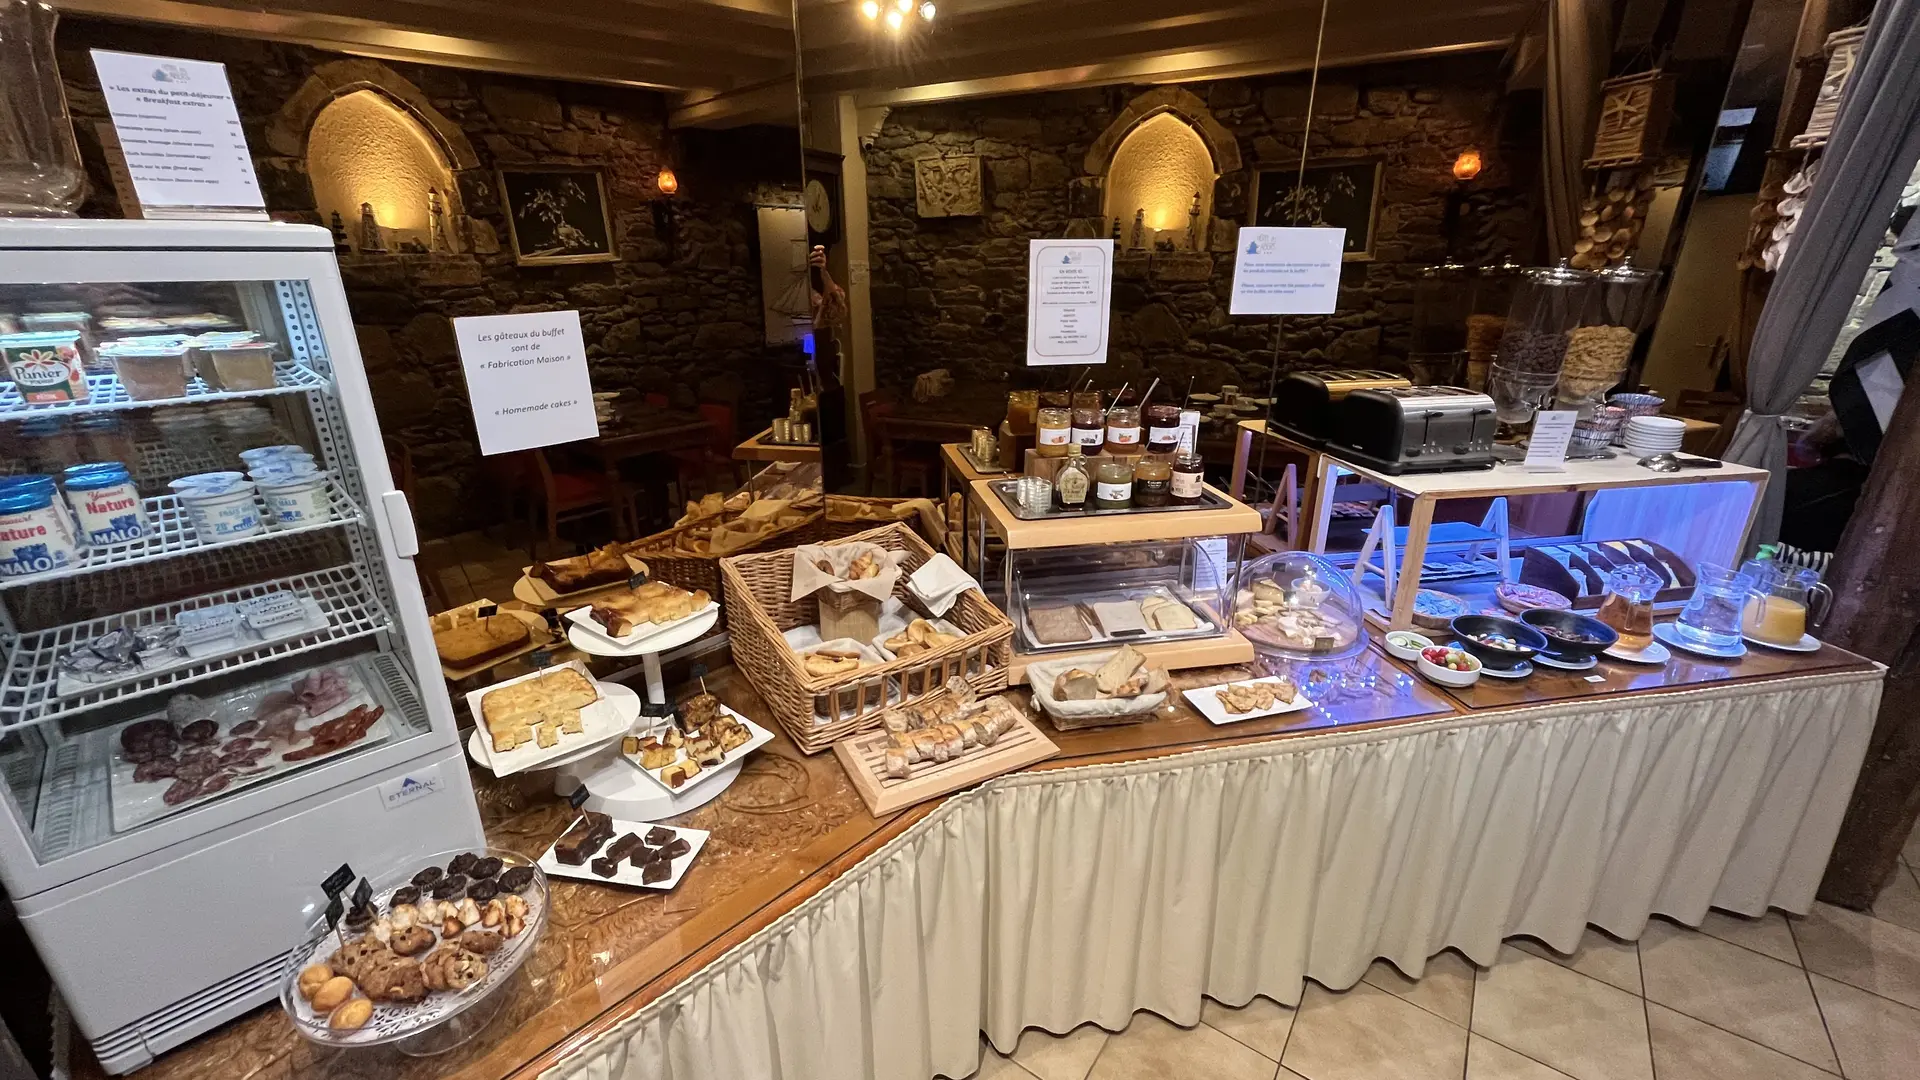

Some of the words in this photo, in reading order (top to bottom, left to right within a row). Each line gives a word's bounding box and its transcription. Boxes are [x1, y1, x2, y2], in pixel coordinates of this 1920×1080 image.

[132, 87, 157, 95] extras
[143, 96, 181, 106] Breakfast
[182, 100, 206, 108] extras
[477, 332, 492, 342] Les
[494, 330, 529, 342] gâteaux
[530, 329, 541, 338] du
[542, 327, 565, 337] buffet
[511, 345, 529, 353] sont
[530, 343, 541, 351] de
[487, 358, 535, 370] Fabrication
[536, 354, 565, 364] Maison
[13, 366, 63, 381] Panier
[502, 402, 549, 415] Homemade
[550, 400, 572, 409] cakes
[85, 497, 135, 514] Nature
[0, 525, 47, 541] ature
[94, 525, 141, 545] MALO
[388, 780, 436, 801] ETERNAL
